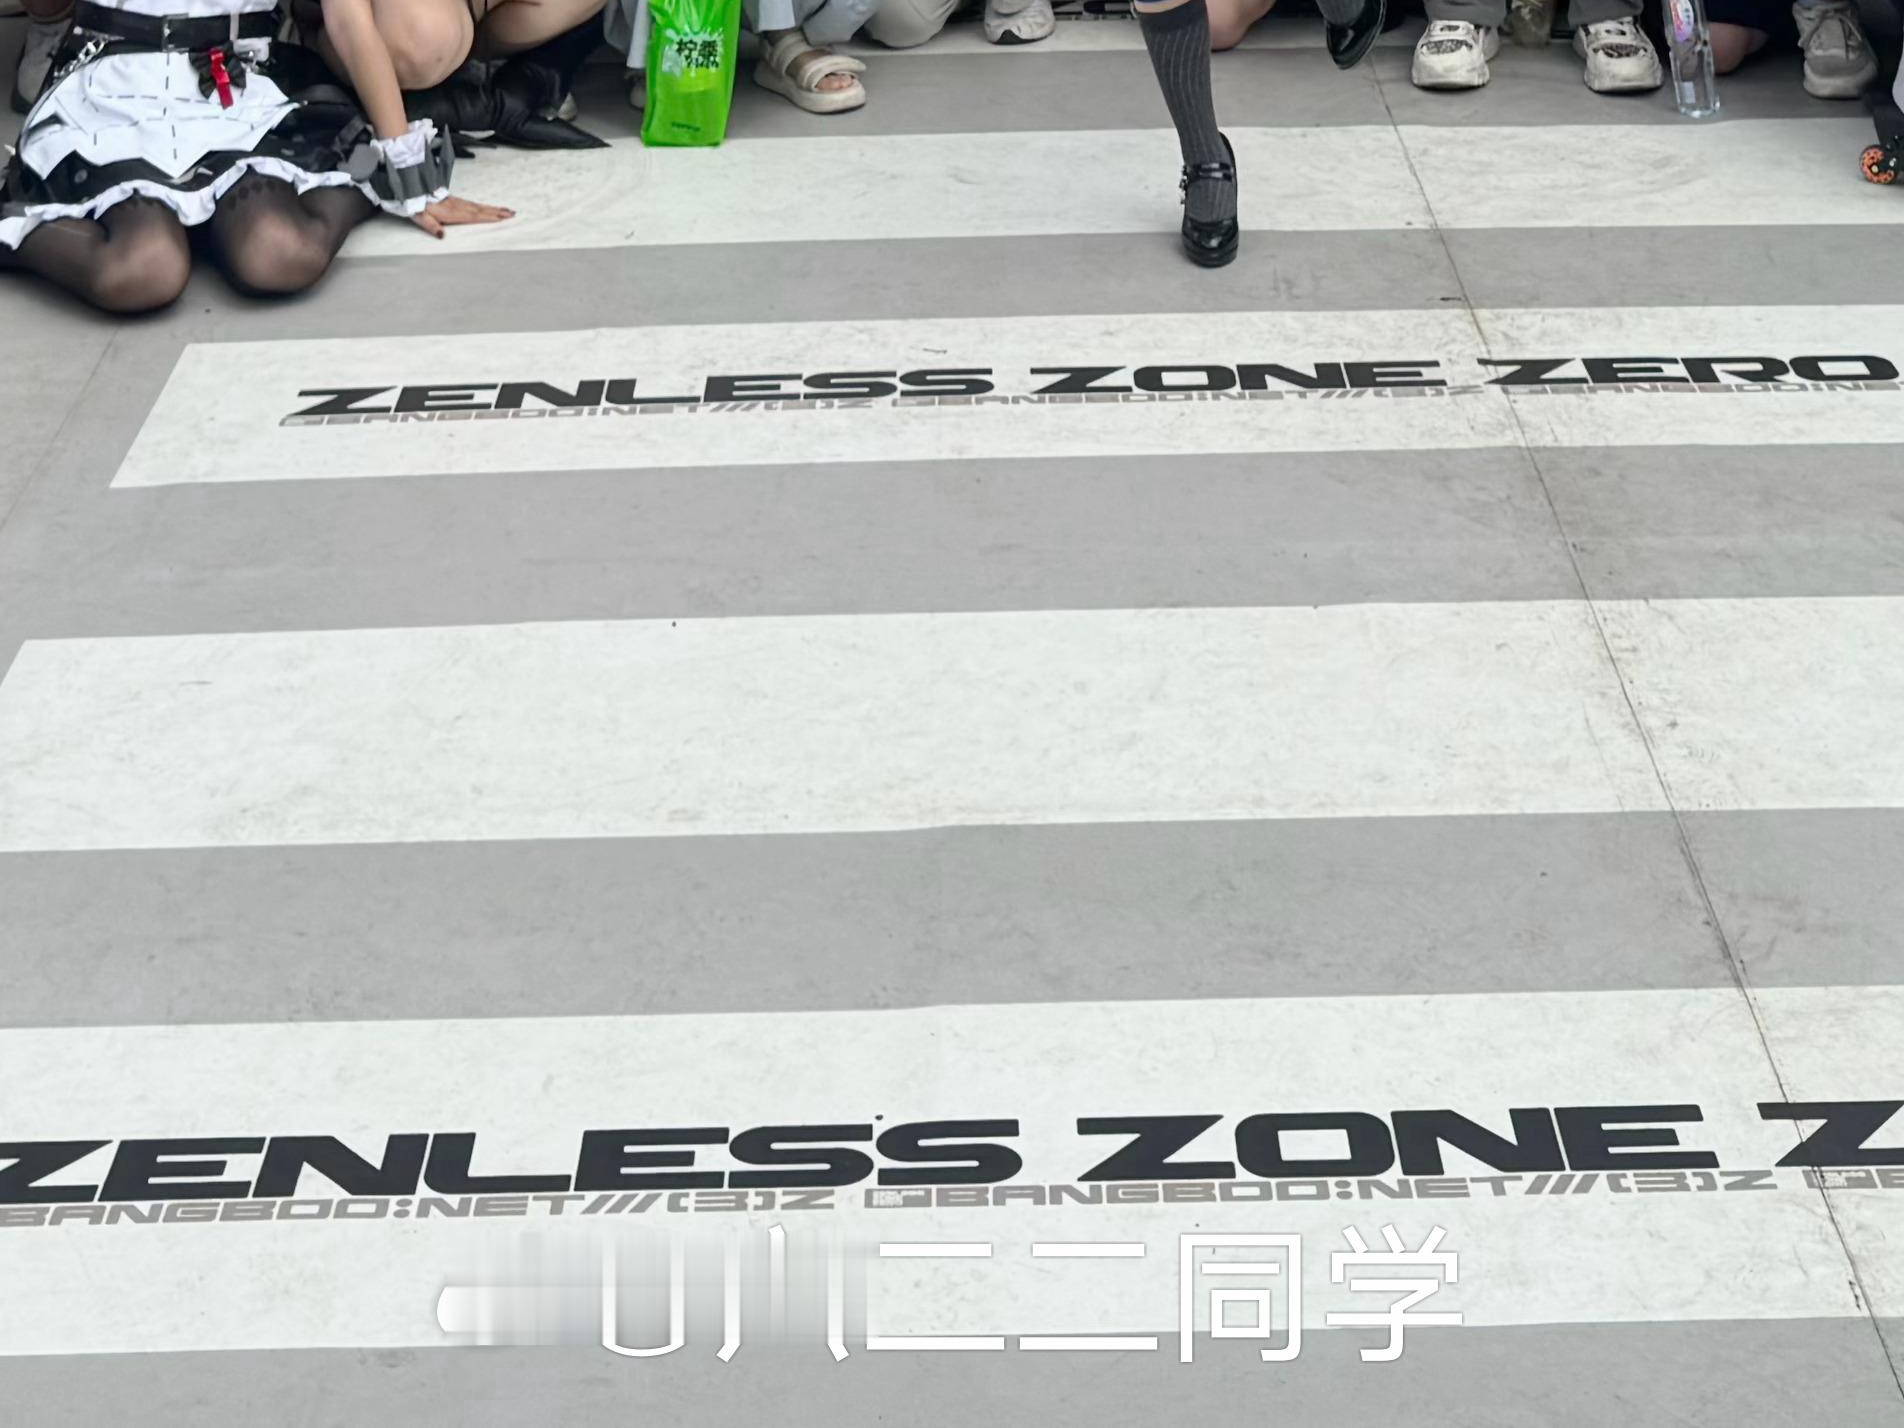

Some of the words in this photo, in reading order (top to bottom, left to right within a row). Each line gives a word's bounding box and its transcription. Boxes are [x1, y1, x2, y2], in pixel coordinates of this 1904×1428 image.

[297, 367, 994, 418] ZENLESS
[1029, 359, 1447, 396] ZONE
[1477, 354, 1900, 387] ZERO
[1076, 1103, 1720, 1182] ZONE
